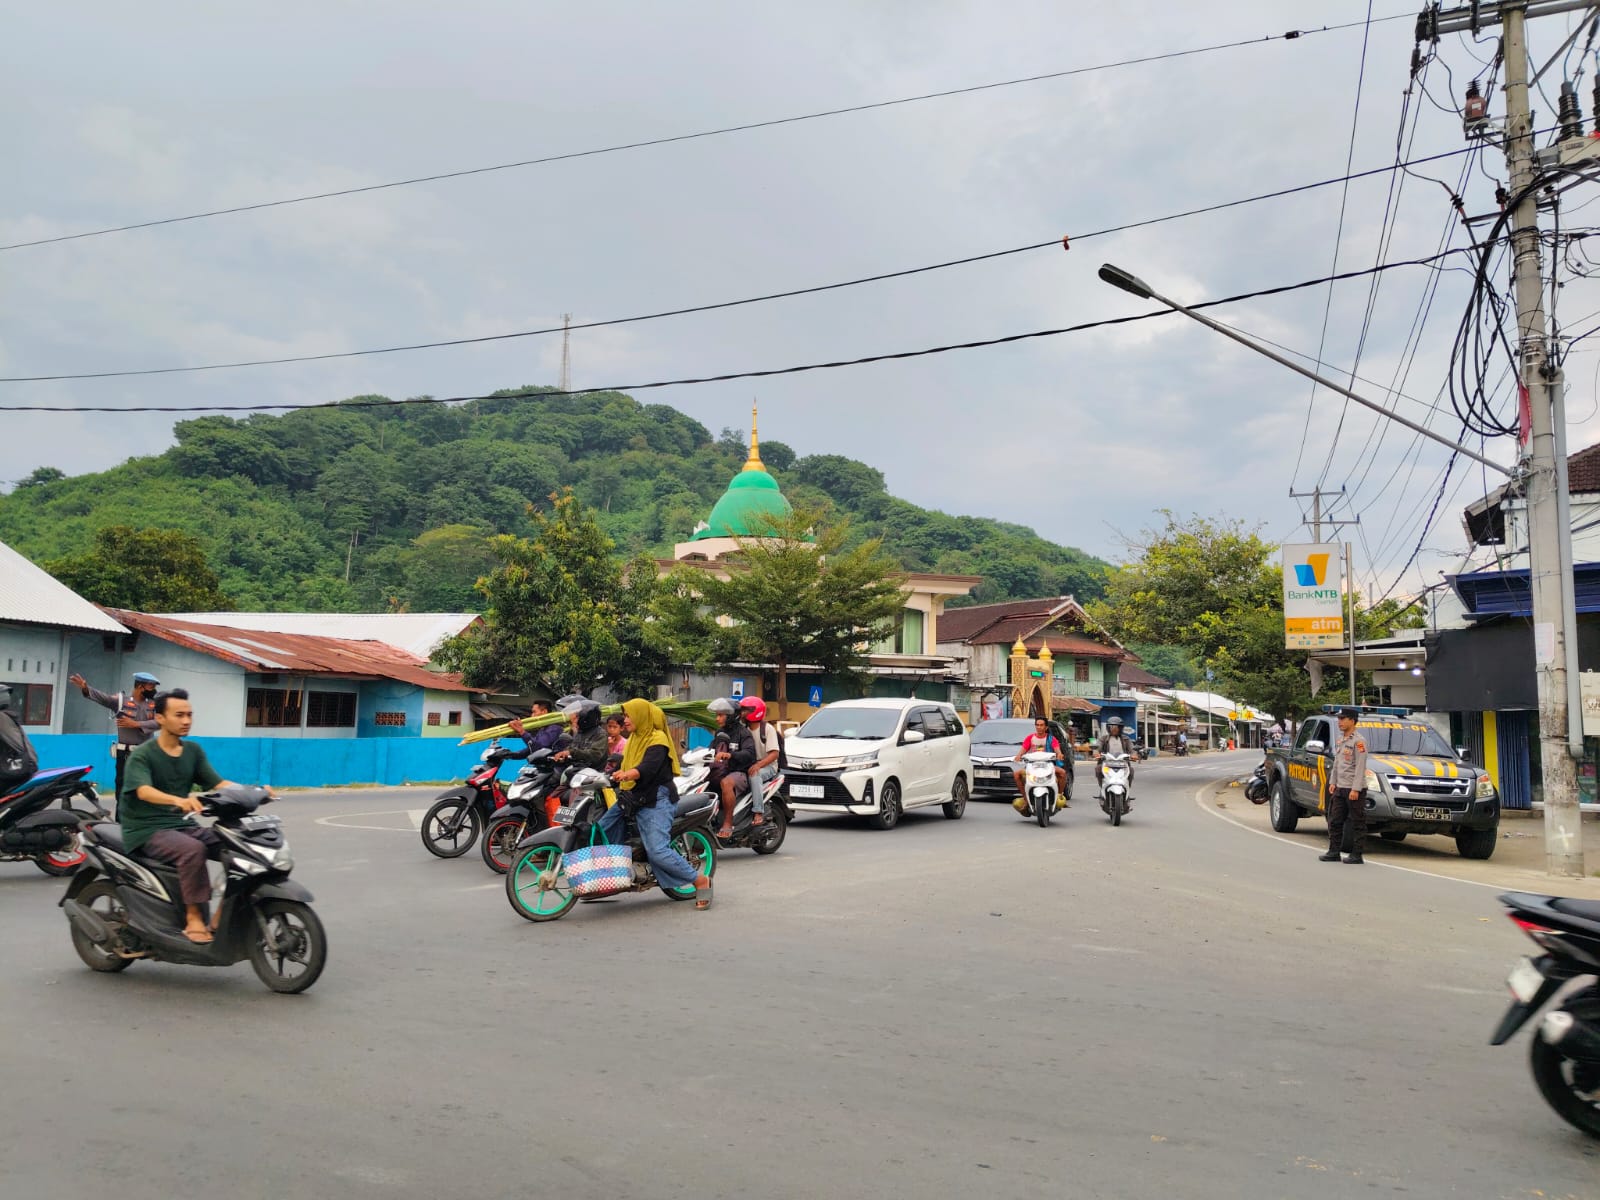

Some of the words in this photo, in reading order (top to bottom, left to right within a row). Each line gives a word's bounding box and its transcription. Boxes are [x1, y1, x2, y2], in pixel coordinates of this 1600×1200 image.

[1288, 590, 1338, 599] BankNTB
[1311, 619, 1341, 630] atm
[1288, 762, 1311, 783] PATROLI
